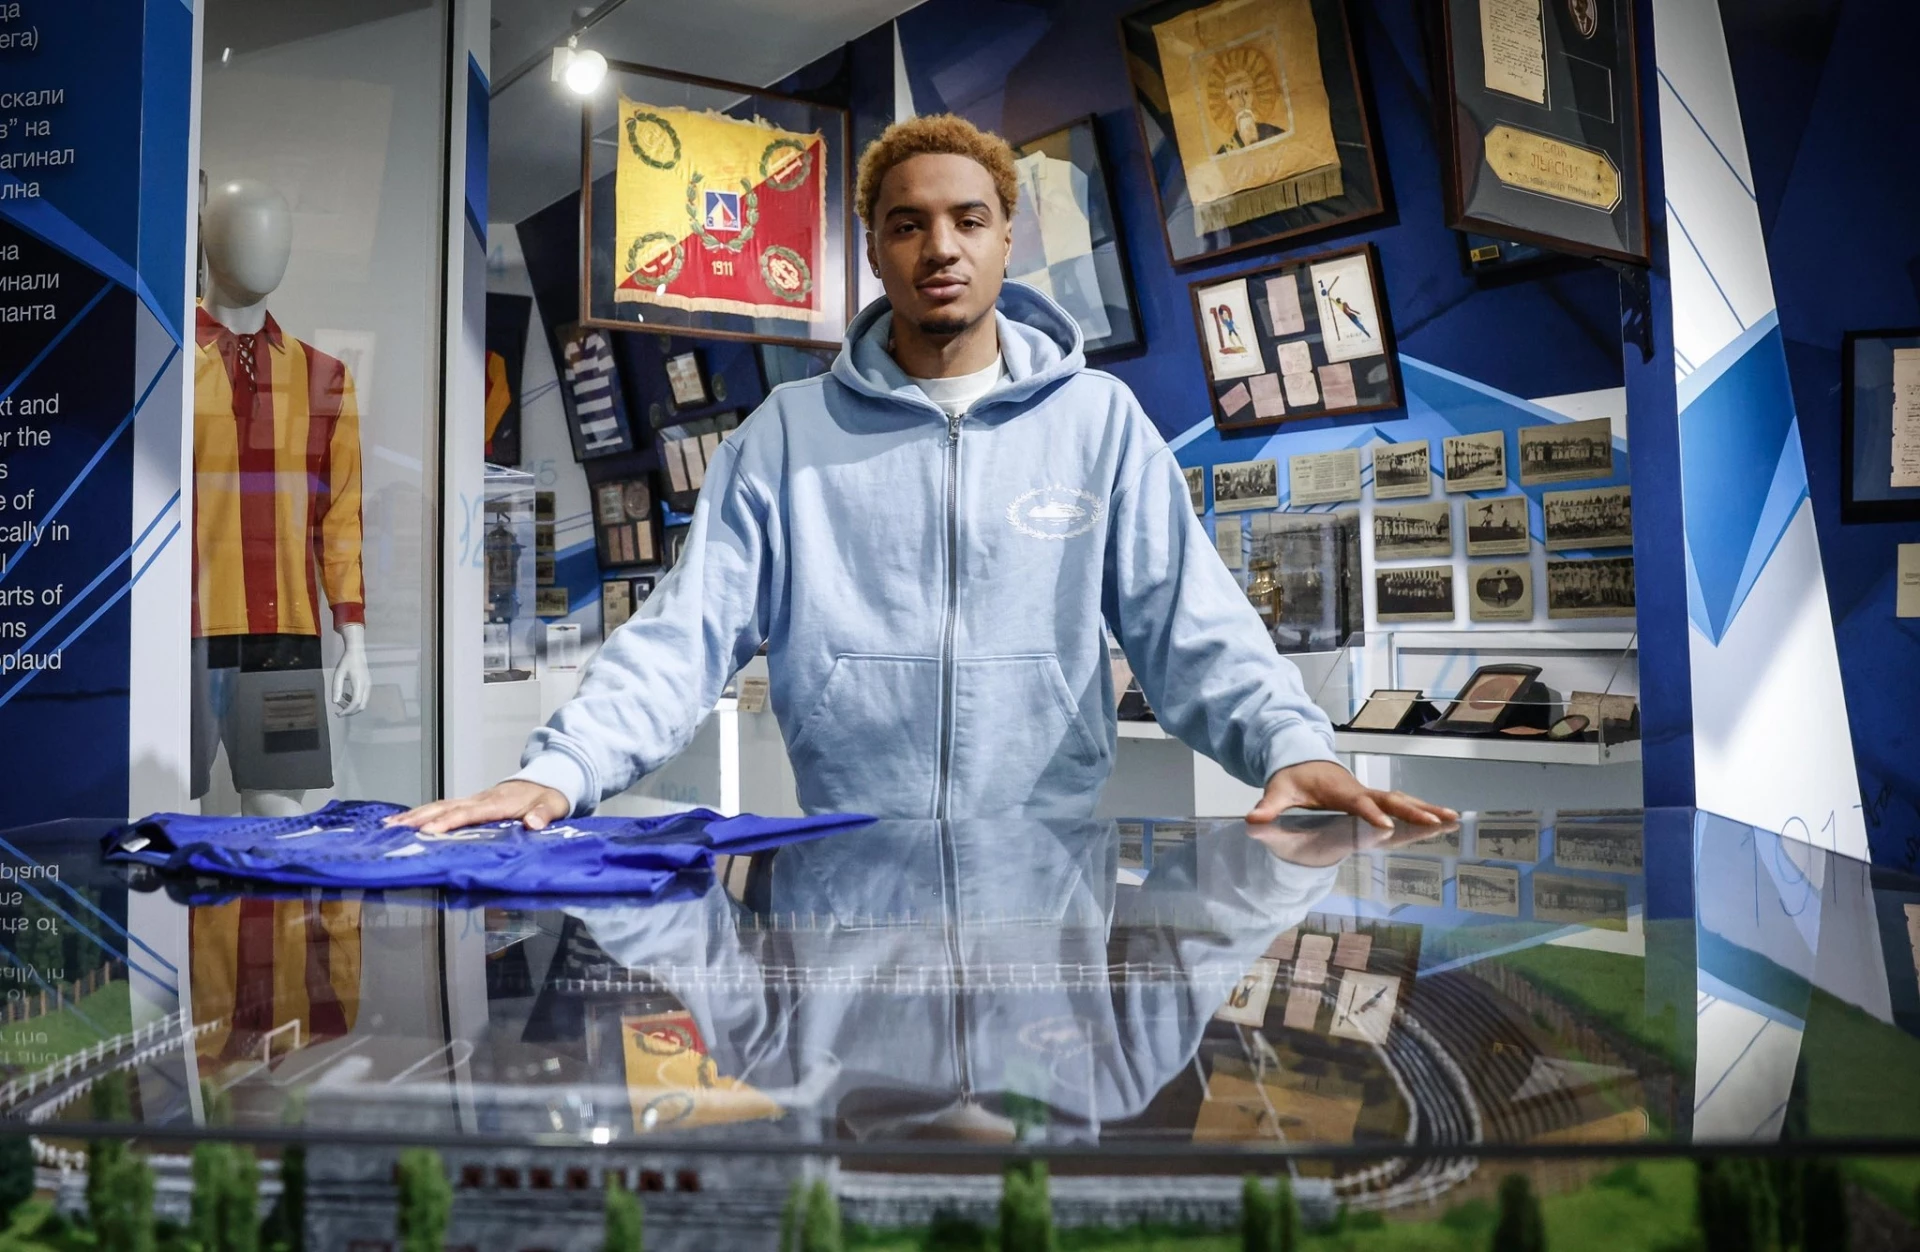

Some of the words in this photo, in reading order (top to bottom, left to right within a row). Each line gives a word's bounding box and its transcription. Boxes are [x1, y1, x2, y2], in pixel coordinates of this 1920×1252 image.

[0, 26, 39, 51] ега)
[0, 89, 64, 108] скали
[25, 120, 51, 137] на
[0, 149, 75, 169] агинал
[0, 182, 40, 200] лна
[20, 393, 59, 415] and
[0, 432, 12, 448] r
[17, 426, 51, 447] the
[13, 489, 35, 510] of
[0, 520, 45, 547] cally
[52, 520, 70, 541] in
[41, 584, 63, 606] of
[0, 621, 27, 638] ns
[0, 648, 62, 676] plaud
